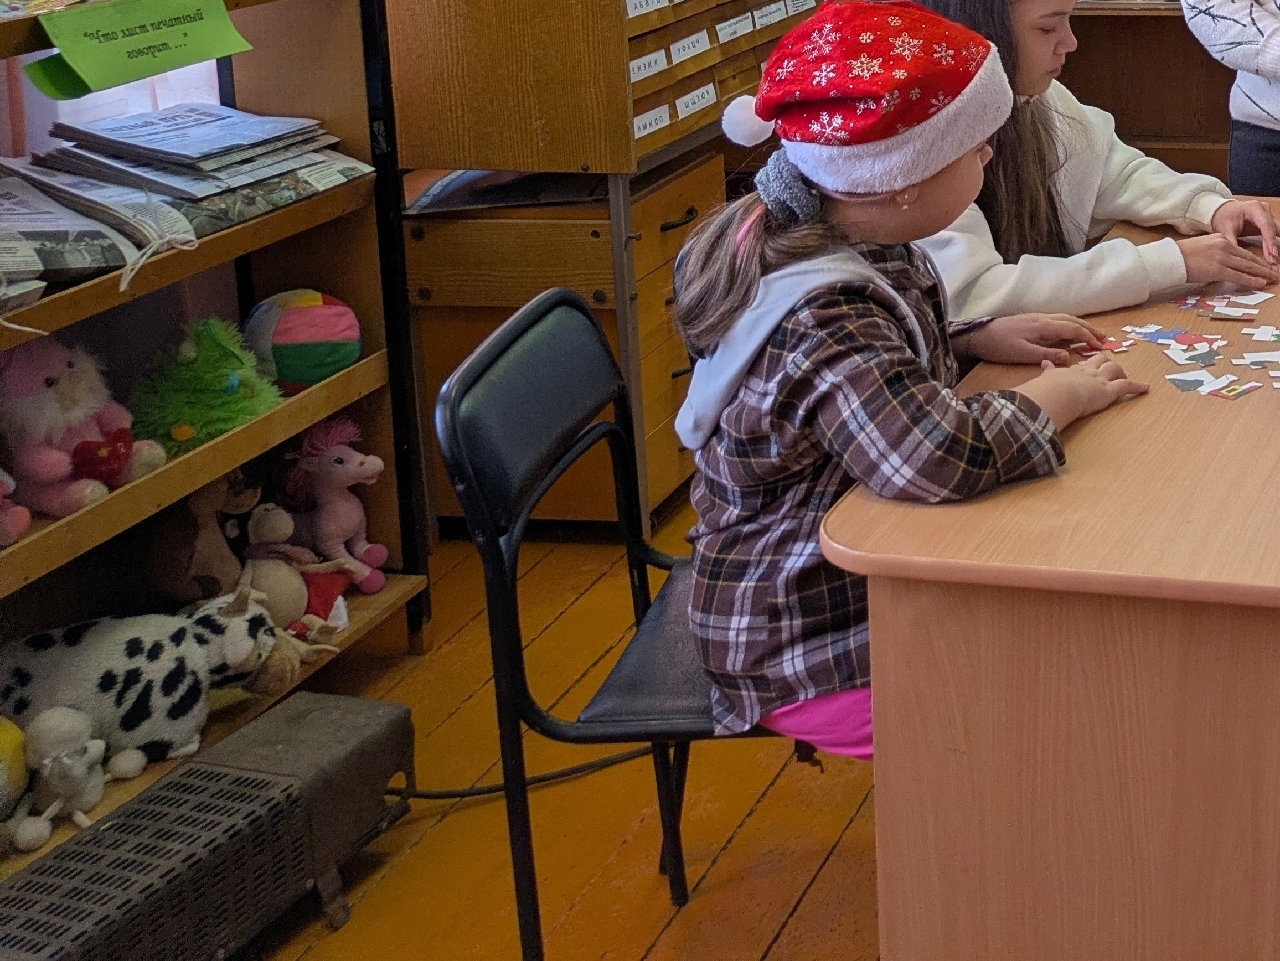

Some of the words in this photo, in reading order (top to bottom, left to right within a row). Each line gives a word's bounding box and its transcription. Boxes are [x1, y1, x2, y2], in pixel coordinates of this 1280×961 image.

[121, 23, 150, 39] лист
[150, 8, 205, 32] печатный
[126, 41, 172, 60] говорит
